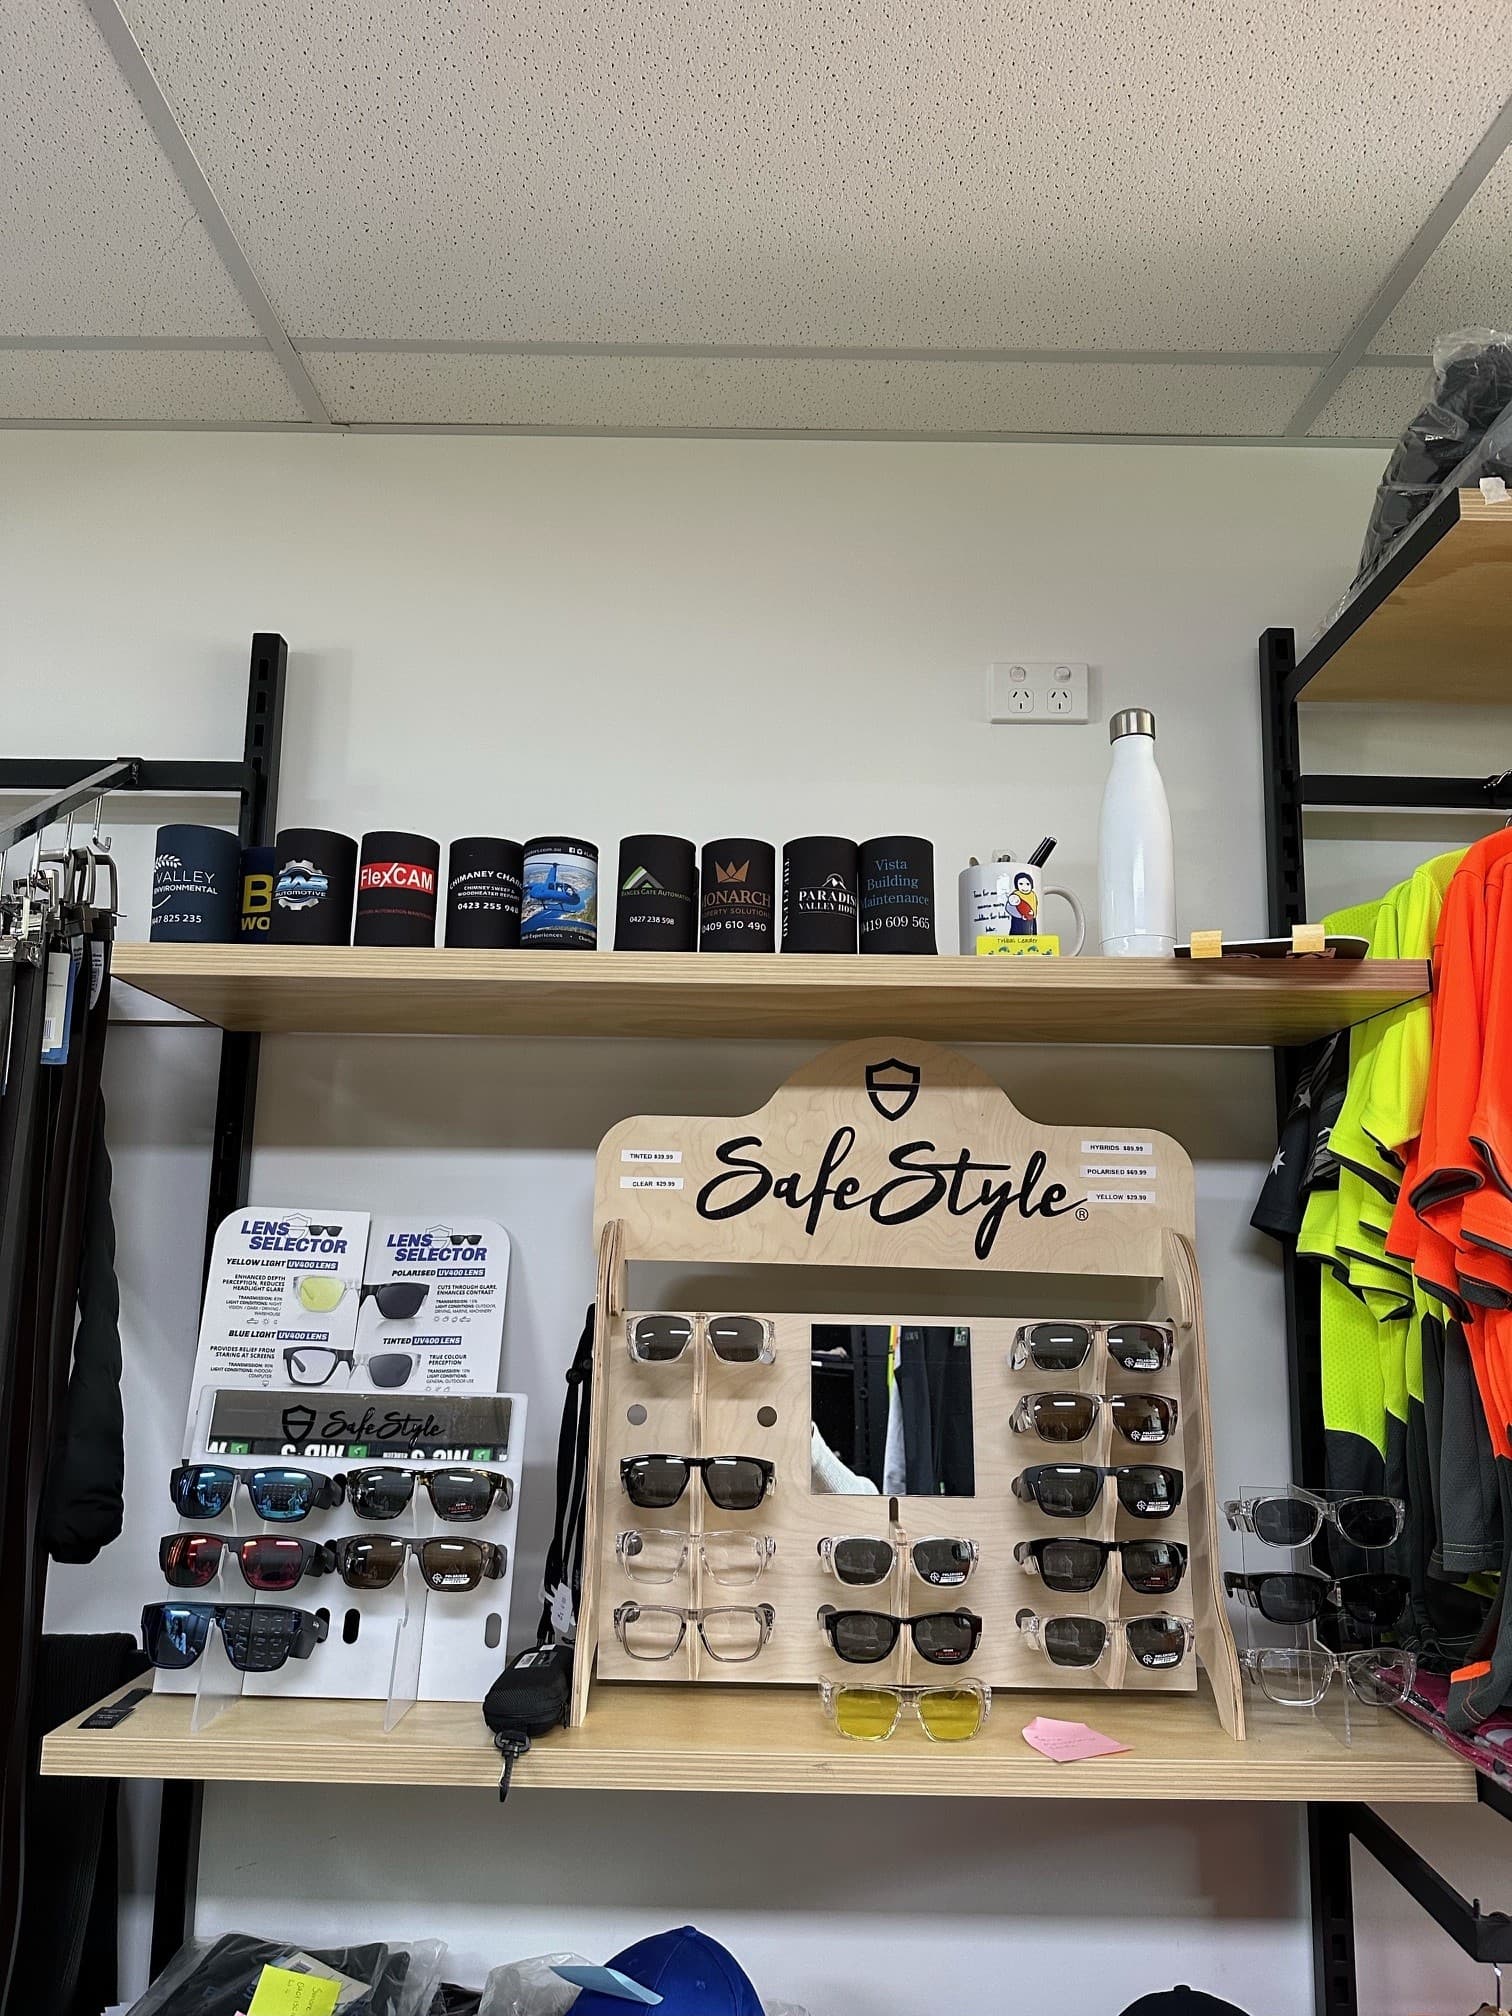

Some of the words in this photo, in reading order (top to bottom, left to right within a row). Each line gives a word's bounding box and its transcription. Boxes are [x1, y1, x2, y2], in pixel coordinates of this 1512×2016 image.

[875, 858, 908, 871] Vista
[156, 870, 215, 884] VALLEY
[361, 863, 433, 890] FlexCAM
[449, 870, 494, 890] CHIMANEY
[867, 874, 920, 891] Building
[457, 902, 480, 910] 0423
[483, 902, 501, 910] 255
[799, 902, 835, 911] VALLEY
[163, 914, 180, 923] 825
[182, 914, 202, 924] 235
[629, 915, 645, 923] 0427
[647, 915, 660, 923] 238
[885, 915, 909, 928] 609
[911, 915, 930, 930] 565
[725, 920, 744, 929] 610
[747, 921, 767, 932] 490
[241, 1220, 291, 1236] LENS
[249, 1236, 347, 1253] SELECTOR
[387, 1233, 434, 1247] LENS
[394, 1247, 487, 1261] SELECTOR
[226, 1258, 260, 1266] YELLOW
[288, 1261, 314, 1269] UV400
[392, 1269, 436, 1277] POLARISED
[251, 1330, 276, 1338] LIGHT
[383, 1337, 411, 1345] TINTED
[321, 1407, 446, 1450] SafeStyle
